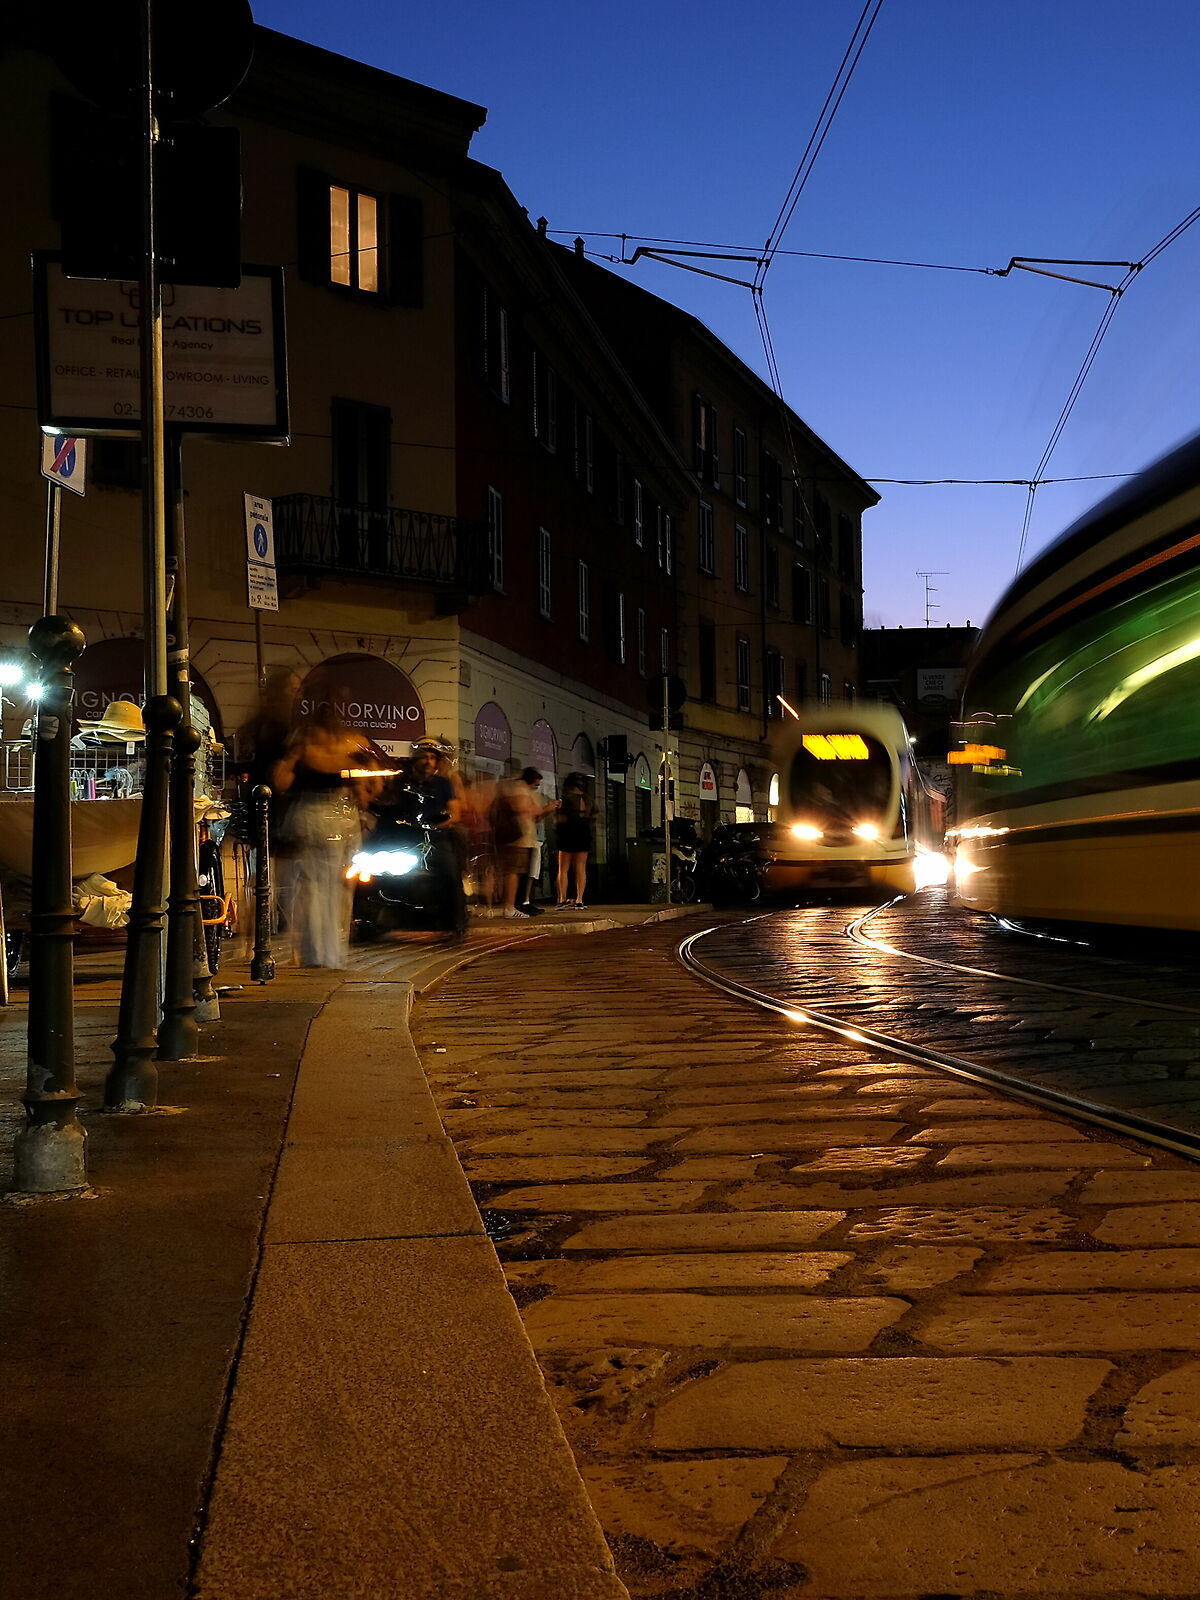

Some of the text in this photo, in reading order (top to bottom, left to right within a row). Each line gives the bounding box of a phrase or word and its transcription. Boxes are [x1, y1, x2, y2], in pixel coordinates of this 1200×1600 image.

[58, 307, 262, 335] TOP LCATIONS
[111, 335, 135, 346] Real
[172, 339, 214, 351] Agency
[55, 364, 97, 378] OFFICE
[106, 367, 141, 379] RETAIL
[165, 370, 224, 384] OWROOM
[232, 375, 270, 386] LIVING
[113, 402, 214, 419] 02-74306
[352, 720, 369, 729] con
[370, 720, 397, 730] cucina
